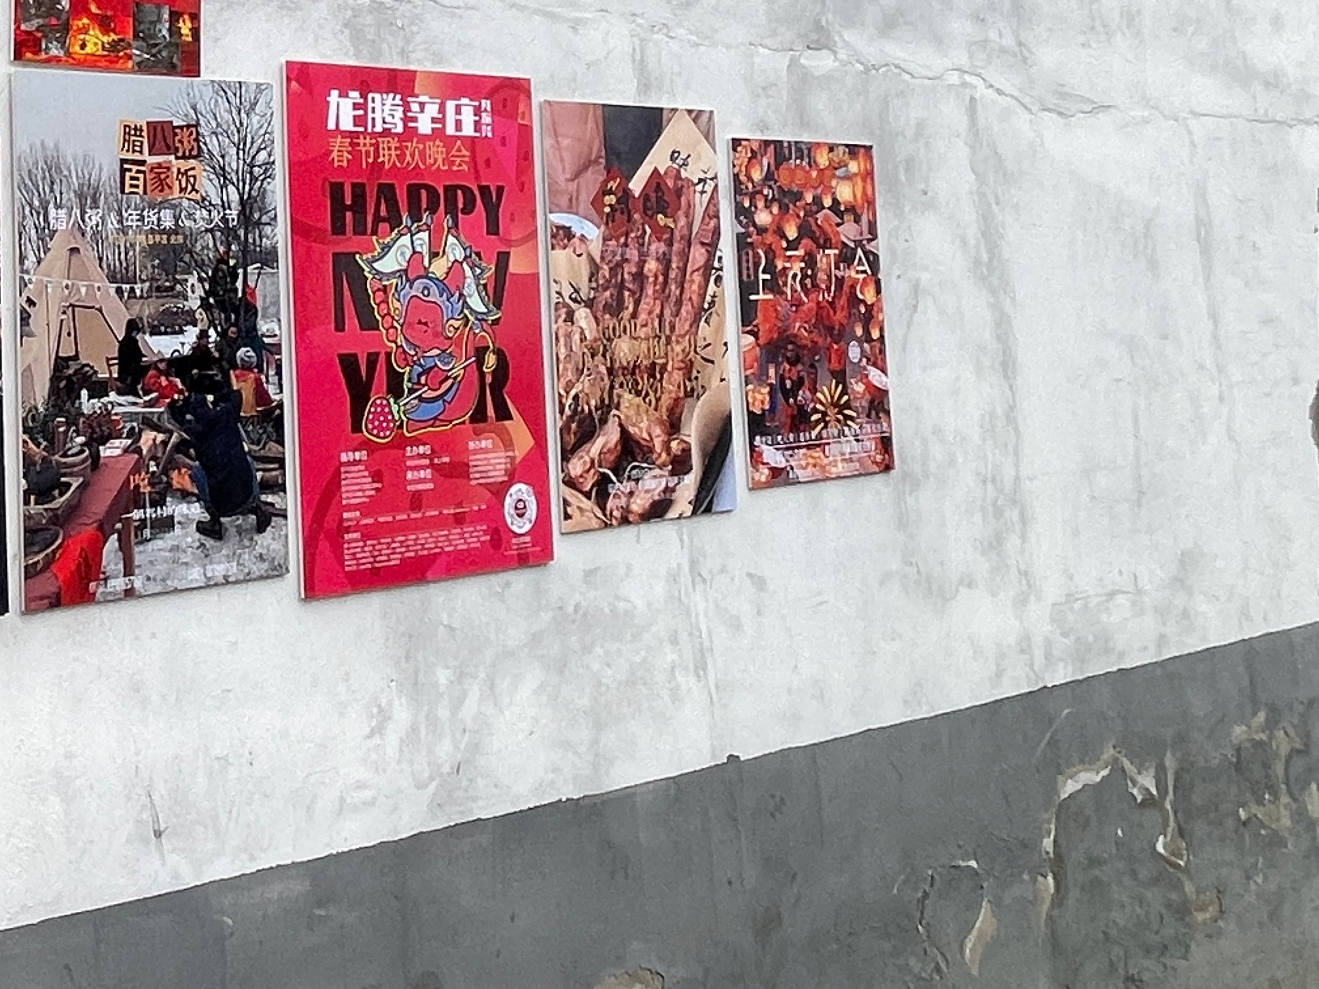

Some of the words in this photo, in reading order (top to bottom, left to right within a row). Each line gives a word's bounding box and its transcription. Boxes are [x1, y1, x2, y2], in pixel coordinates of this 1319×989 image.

[326, 89, 481, 137] 龙腾辛庄
[121, 123, 199, 156] 腊八粥
[329, 134, 472, 172] 春节联欢晚会
[124, 164, 200, 196] 百家饭
[328, 181, 506, 237] HAPPY
